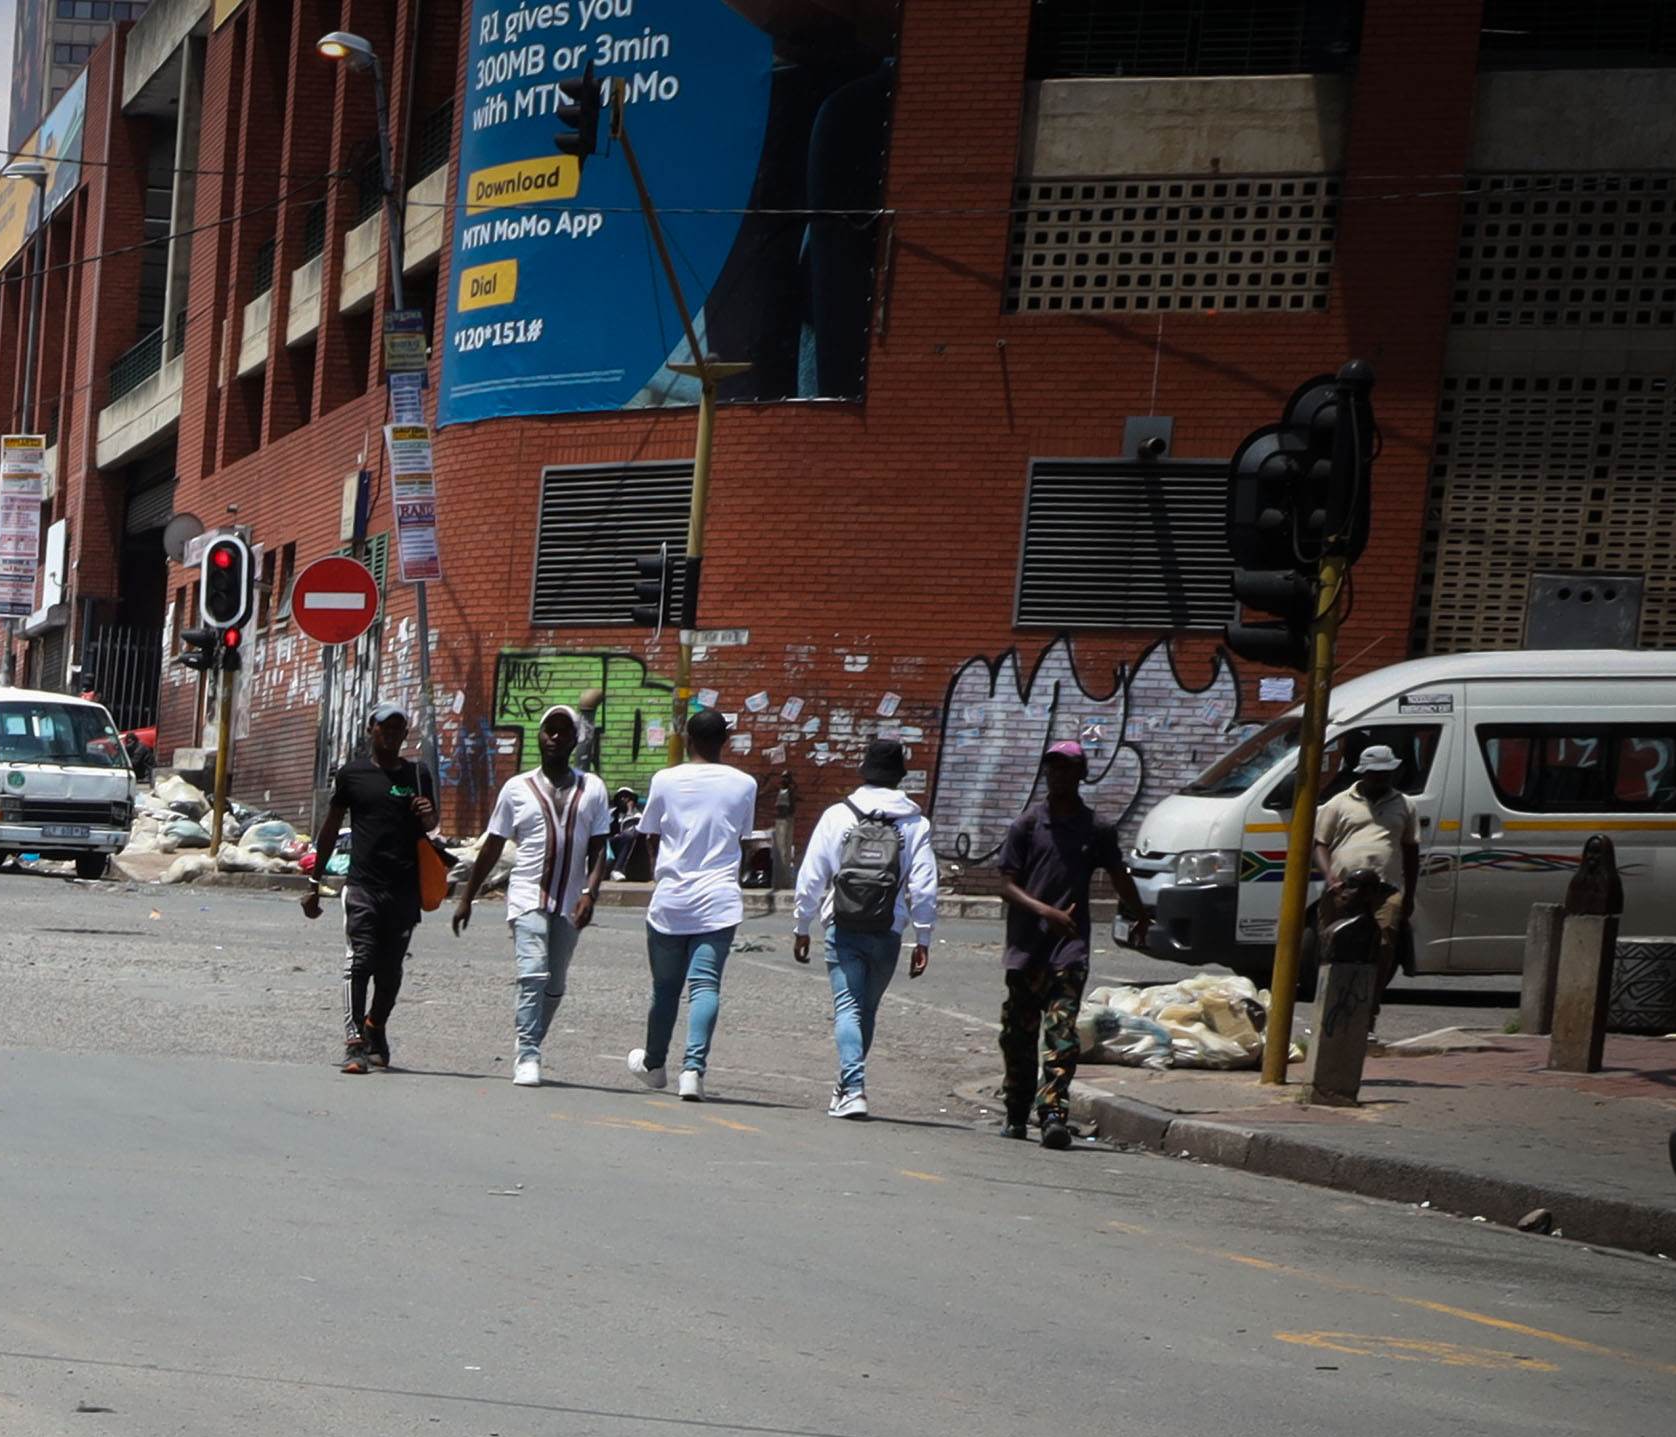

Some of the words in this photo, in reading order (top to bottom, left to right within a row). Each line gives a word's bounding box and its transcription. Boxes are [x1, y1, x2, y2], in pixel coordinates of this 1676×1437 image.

[479, 10, 498, 45] R1
[503, 2, 569, 44] gives
[579, 0, 633, 31] you
[475, 44, 545, 90] 300MB
[553, 44, 587, 71] or
[593, 27, 670, 66] 3min
[472, 92, 508, 131] with
[476, 166, 560, 201] Download
[462, 222, 490, 250] MTN
[493, 213, 551, 244] MoMo
[555, 210, 603, 239] App
[470, 273, 497, 298] Dial
